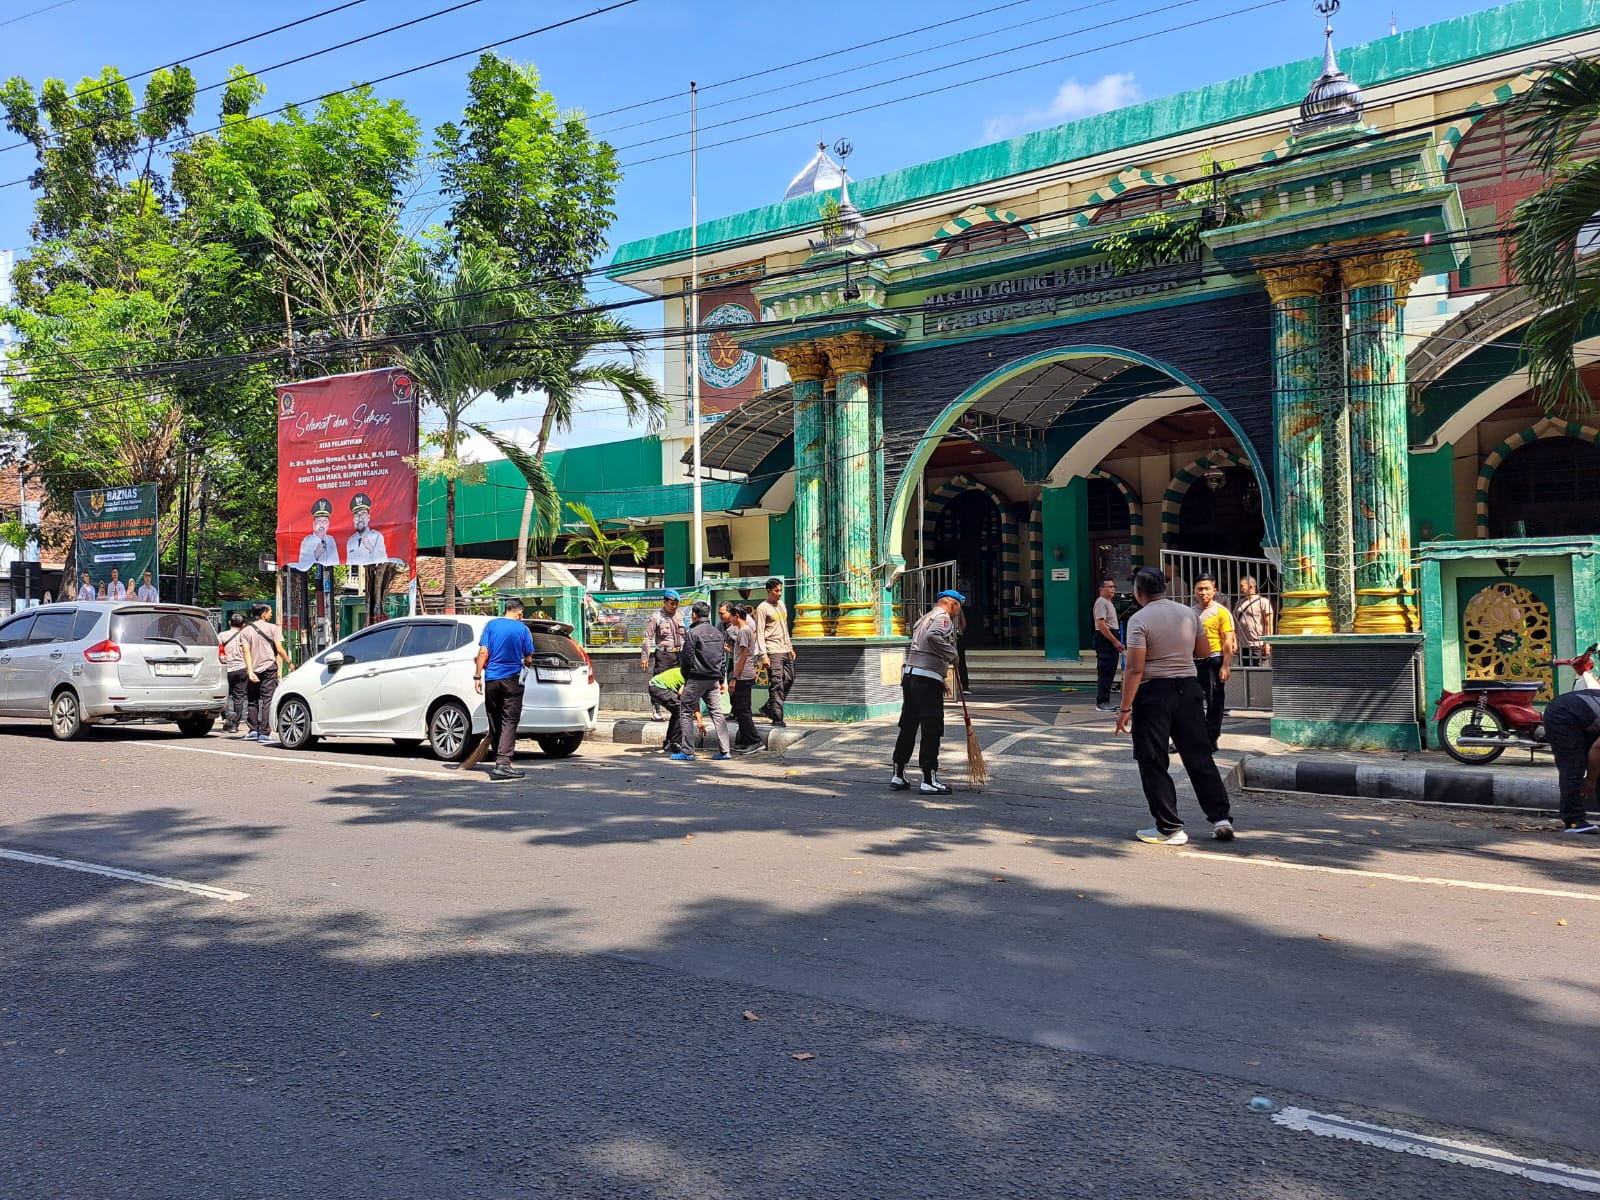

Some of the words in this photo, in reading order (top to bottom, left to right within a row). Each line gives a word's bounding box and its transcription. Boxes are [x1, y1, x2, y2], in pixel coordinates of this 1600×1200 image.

[989, 274, 1047, 299] AGUNG
[296, 411, 336, 437] Selamat
[352, 403, 391, 429] Sukses
[362, 468, 389, 477] NGANJUK
[106, 488, 138, 501] BAZNAS
